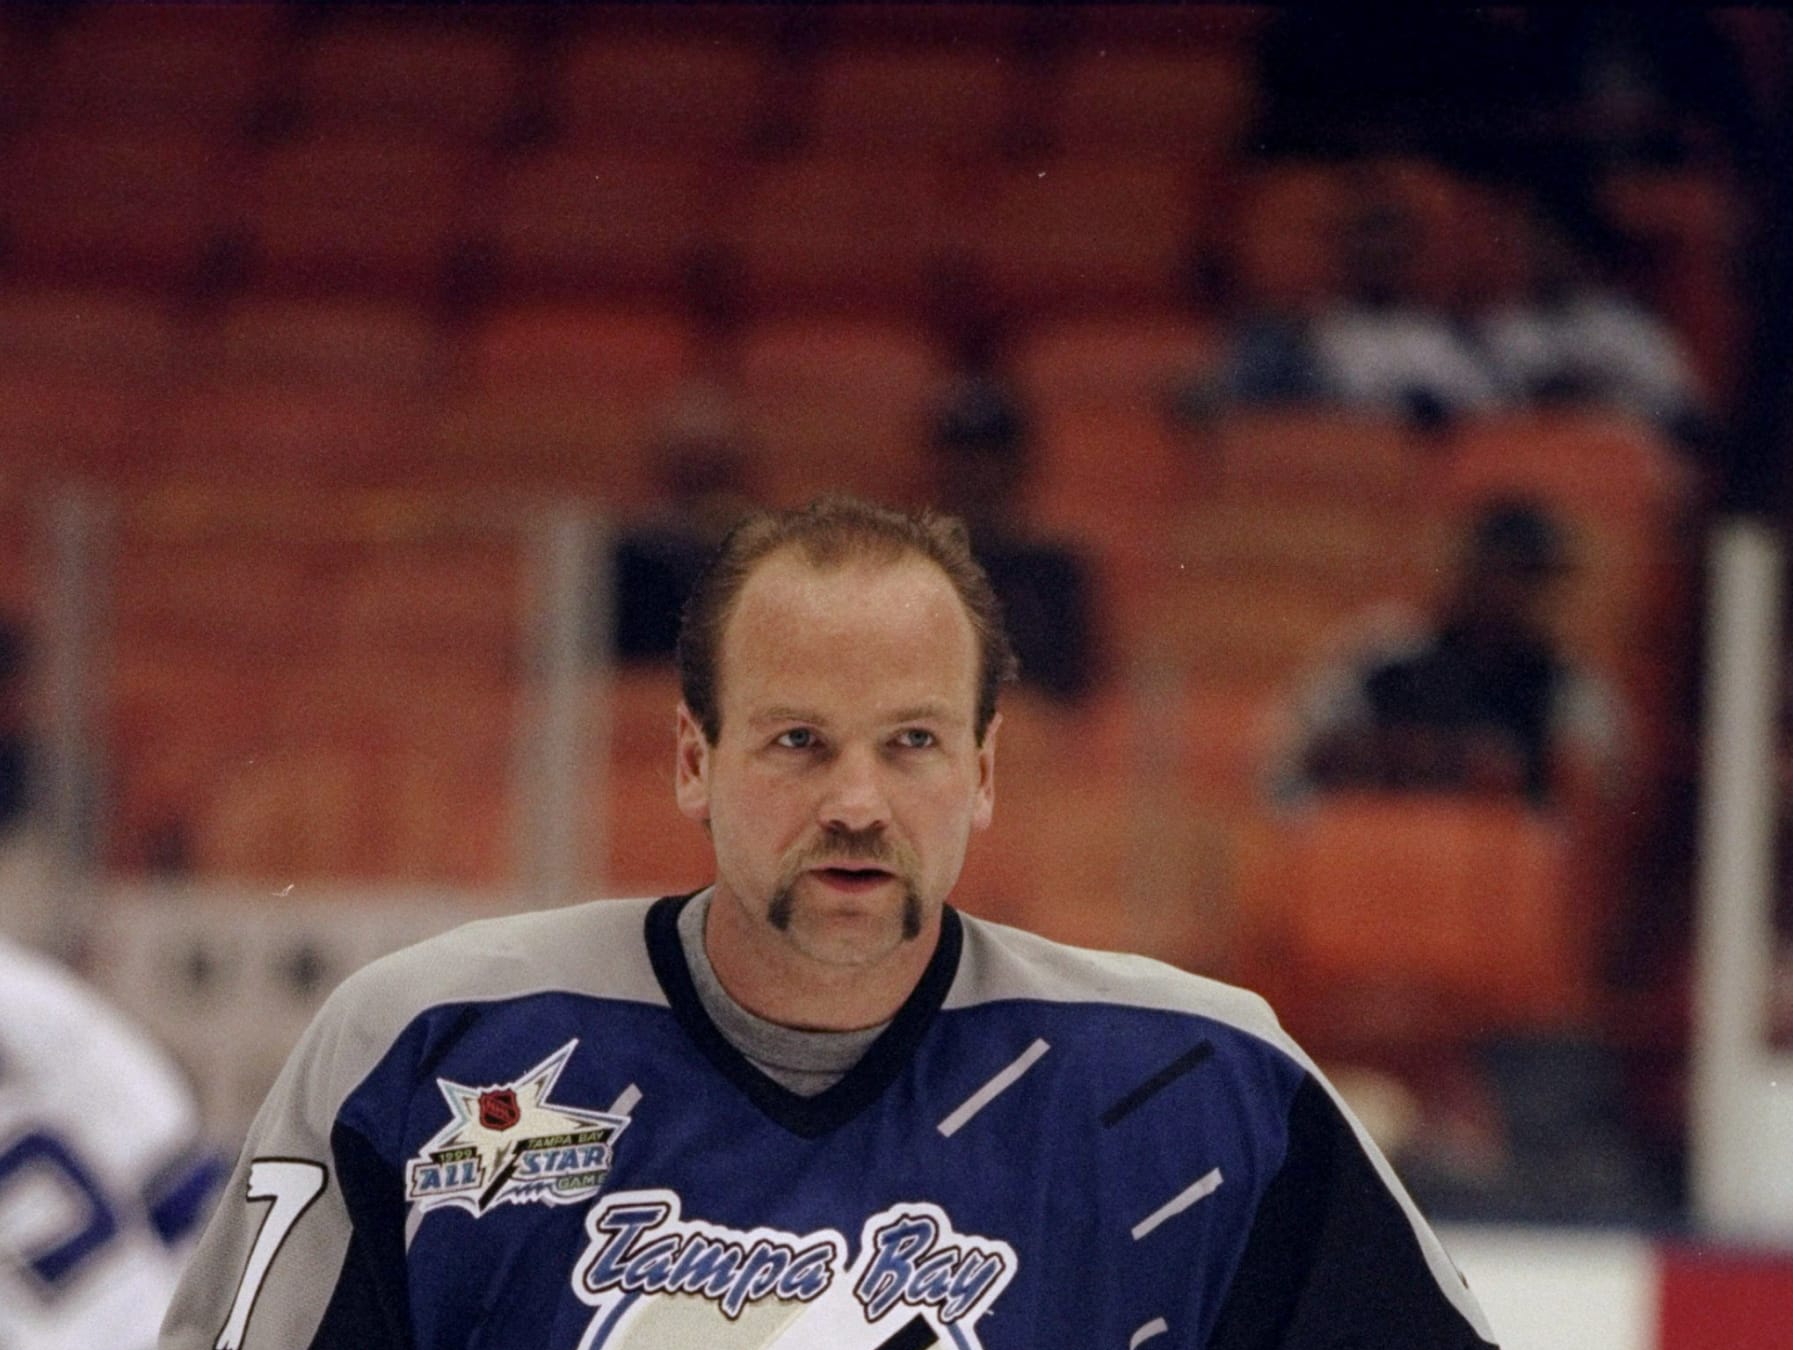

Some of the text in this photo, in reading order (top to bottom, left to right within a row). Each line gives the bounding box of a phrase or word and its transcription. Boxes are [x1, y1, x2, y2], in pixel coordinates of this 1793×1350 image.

[438, 1130, 605, 1164] 1999 TAMPA BAY
[419, 1149, 606, 1191] ALL STAR
[558, 1171, 606, 1190] GAME
[583, 1203, 1005, 1323] Tampa Bay
